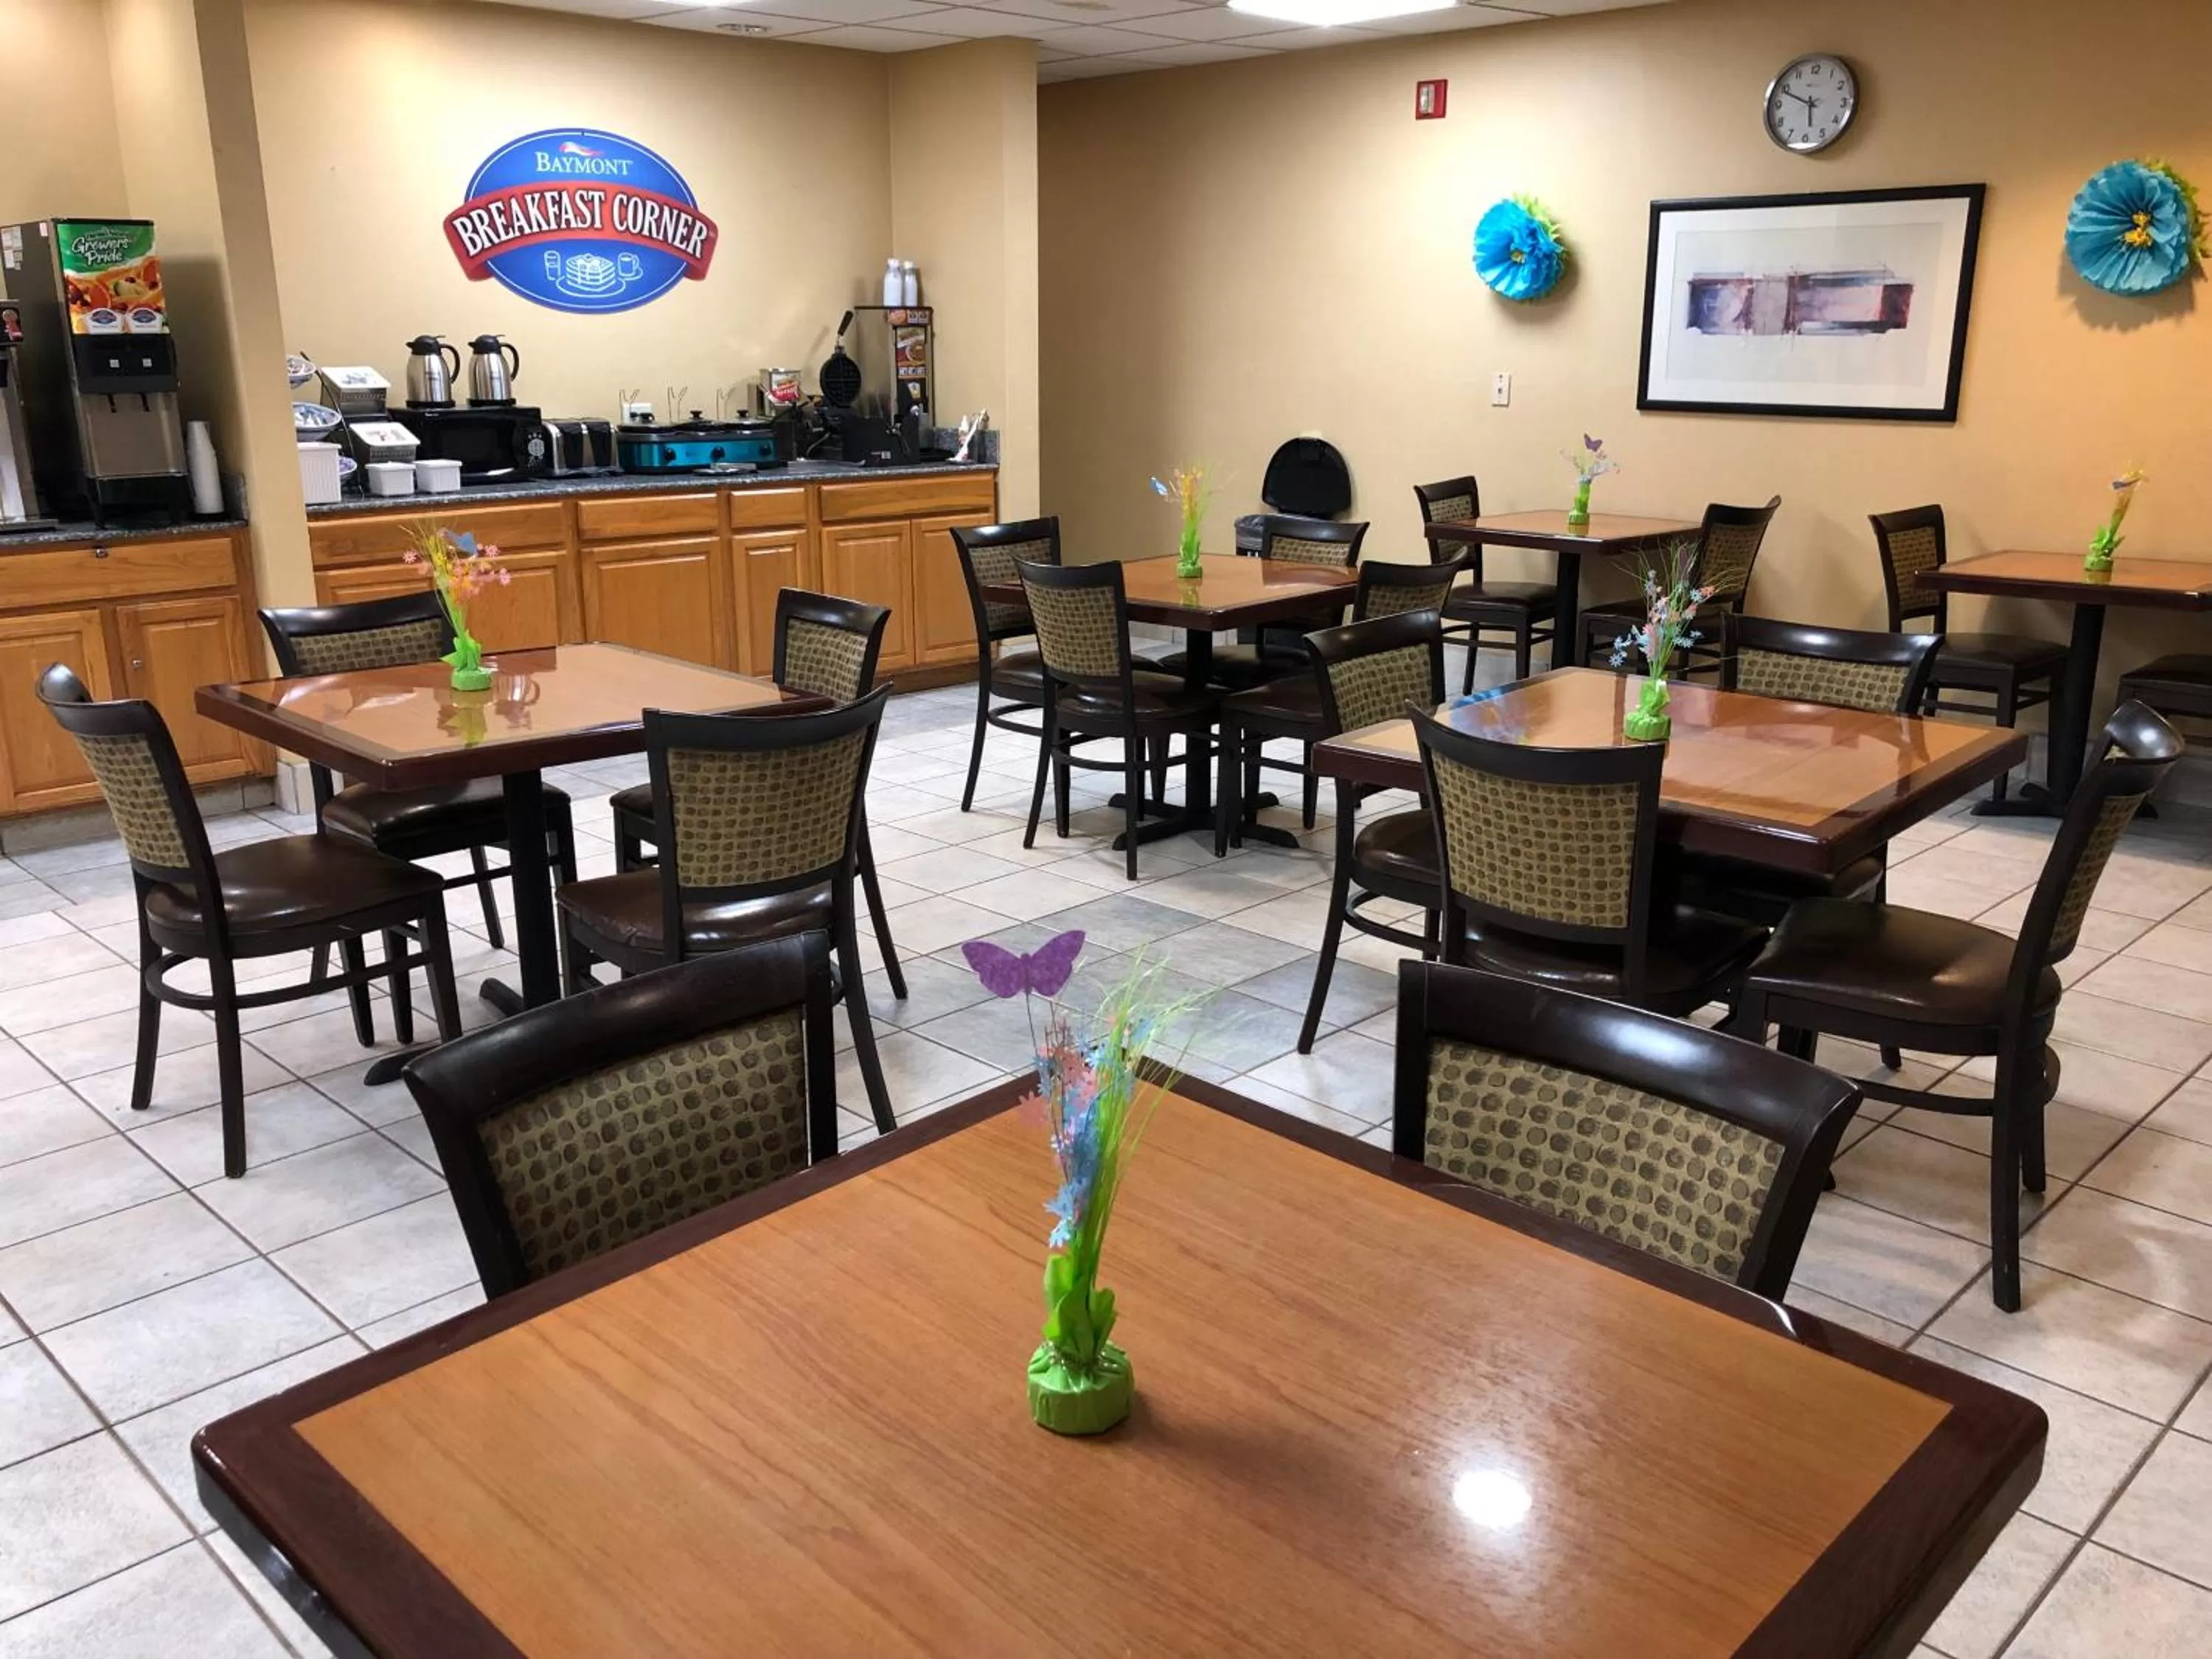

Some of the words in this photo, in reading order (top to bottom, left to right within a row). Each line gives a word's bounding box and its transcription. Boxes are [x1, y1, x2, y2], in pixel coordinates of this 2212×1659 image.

[535, 151, 633, 175] BAYMONT
[452, 189, 606, 257] BREAKFAST
[613, 192, 709, 258] CORNER
[85, 247, 122, 265] Pride
